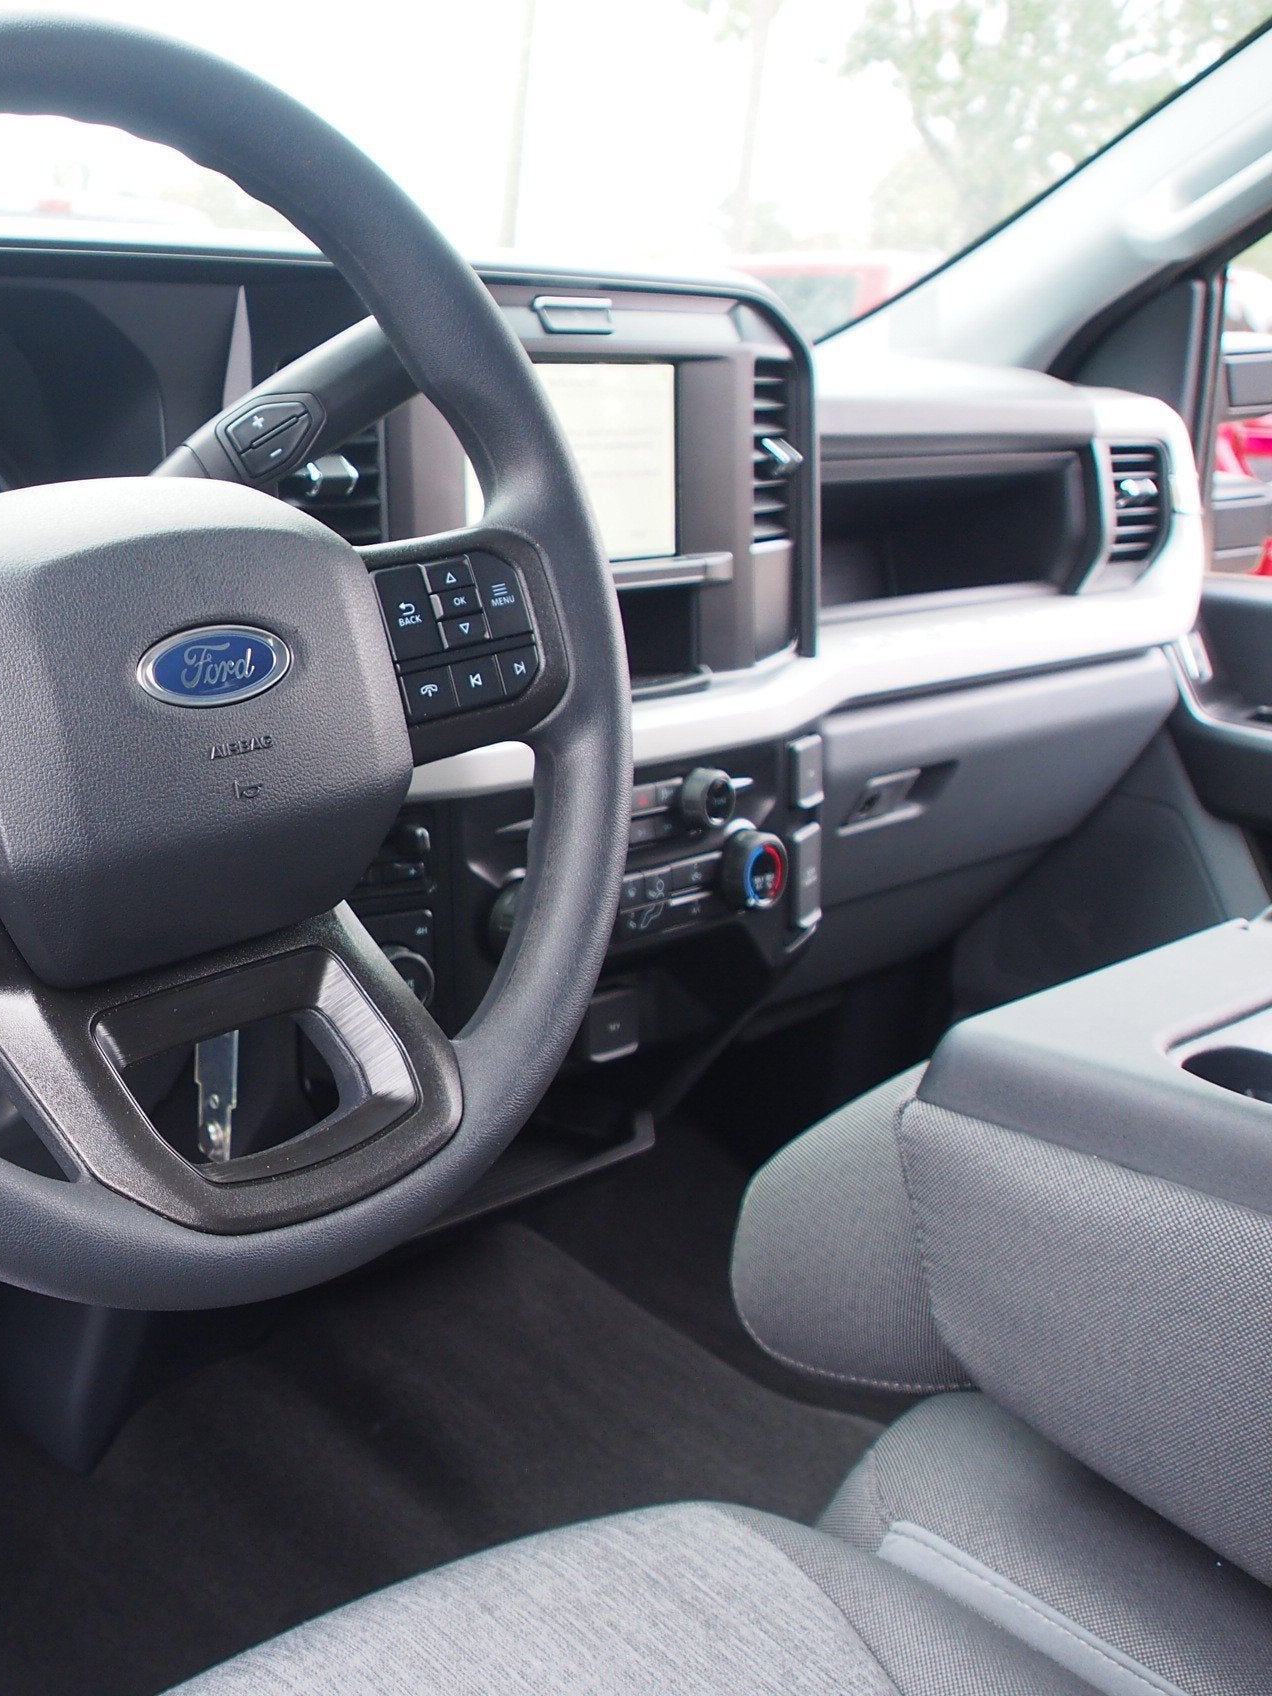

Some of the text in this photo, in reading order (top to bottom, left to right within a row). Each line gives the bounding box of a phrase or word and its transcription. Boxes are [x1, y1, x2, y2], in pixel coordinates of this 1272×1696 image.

[453, 596, 467, 606] OK
[491, 595, 515, 607] MENU
[398, 614, 422, 627] BACK
[181, 642, 255, 689] Ford
[210, 735, 275, 760] AIRBAG
